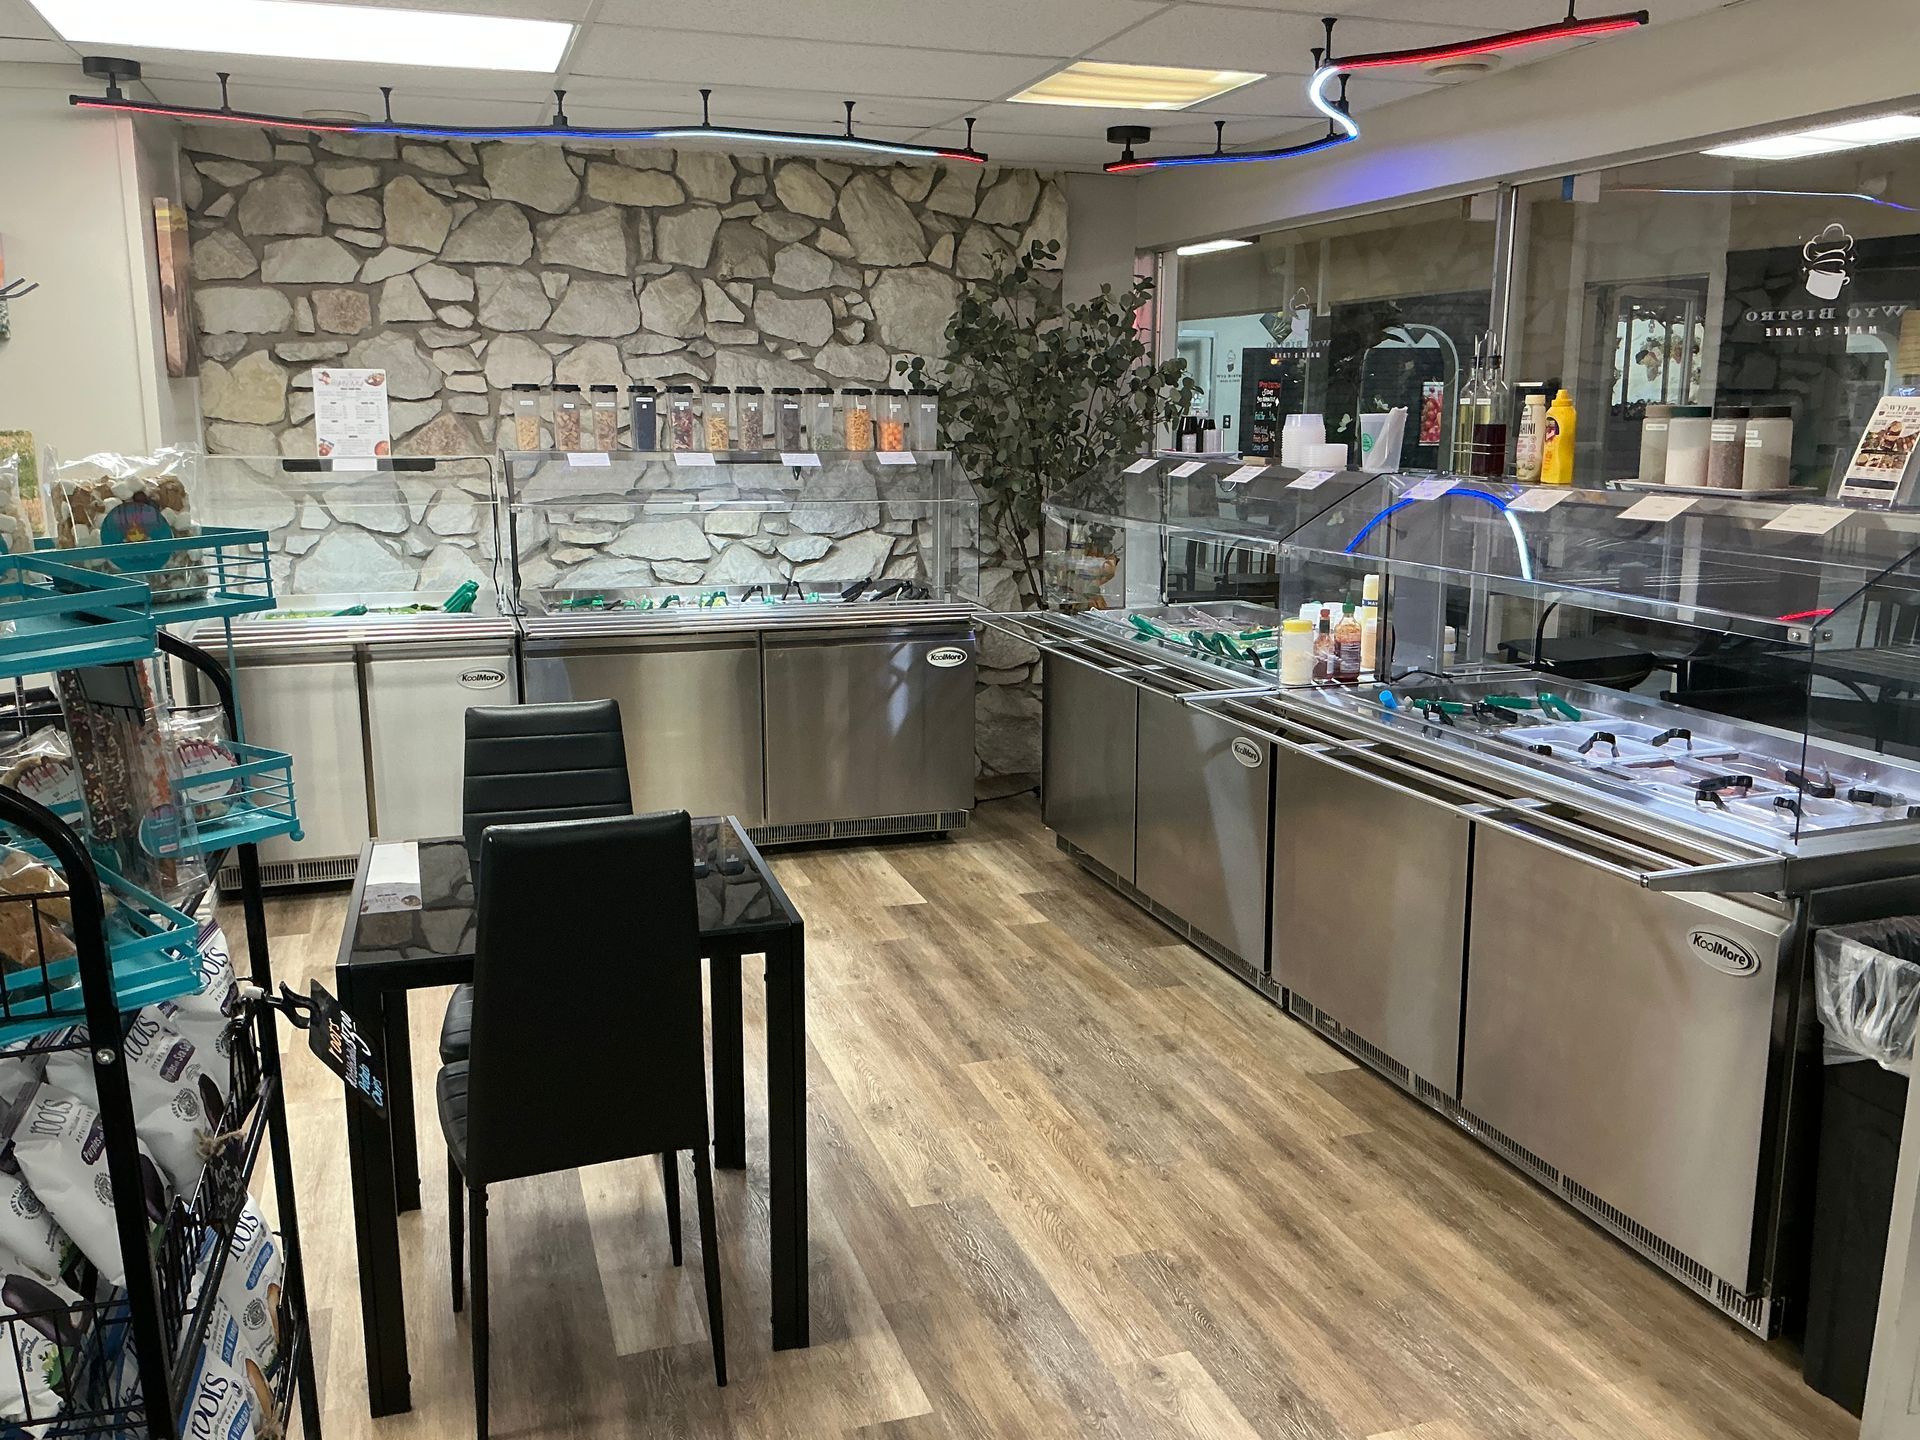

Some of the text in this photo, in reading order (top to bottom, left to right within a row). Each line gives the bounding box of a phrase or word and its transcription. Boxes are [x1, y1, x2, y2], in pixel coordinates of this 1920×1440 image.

[930, 653, 962, 661] KoolMore
[461, 673, 500, 682] KoolMore
[1234, 744, 1257, 761] KoolMore
[200, 946, 228, 985] oots
[1693, 933, 1746, 966] KoolMore
[328, 1018, 343, 1063] roots
[29, 1099, 73, 1138] roots
[192, 1372, 229, 1440] roots
[230, 1405, 254, 1436] Vinegar
